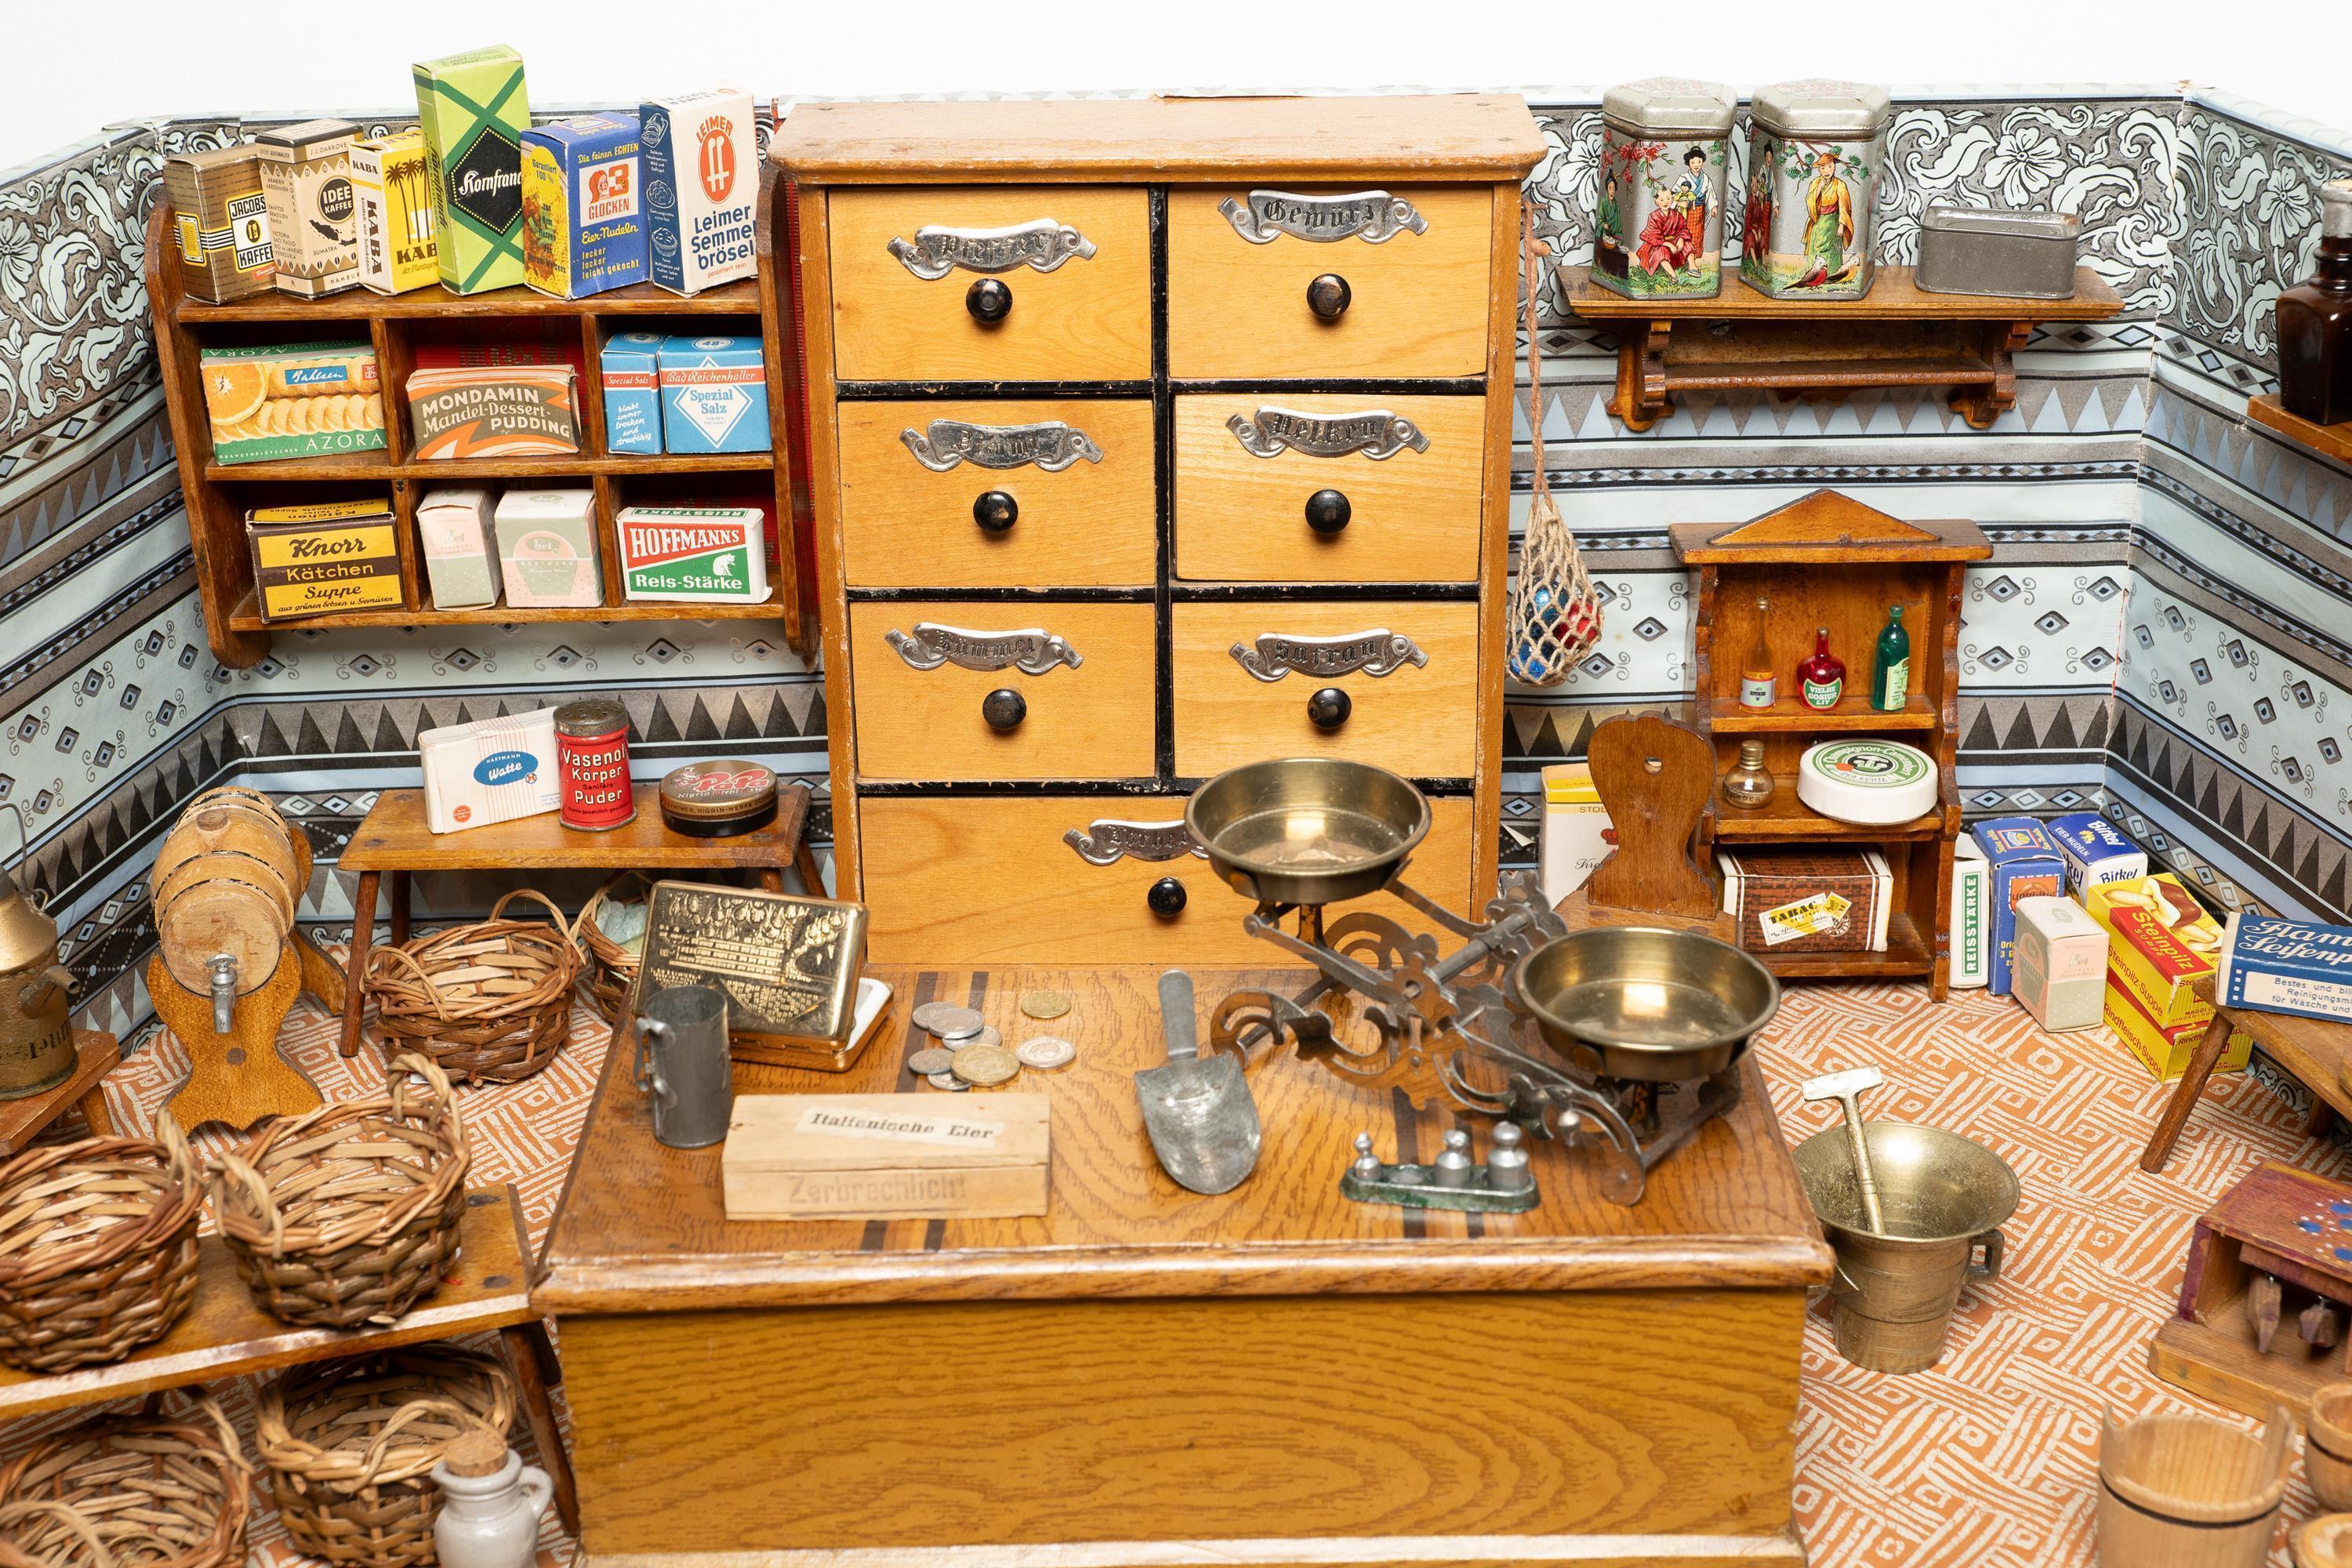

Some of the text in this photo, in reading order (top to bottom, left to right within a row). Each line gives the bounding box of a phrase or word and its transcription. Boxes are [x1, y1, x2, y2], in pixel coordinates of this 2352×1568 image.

[696, 115, 734, 143] LEIMER
[320, 142, 347, 153] DARBOVE
[578, 143, 639, 163] Die feinen ECHTEN
[353, 161, 379, 175] KABA
[532, 159, 557, 175] Garantiert
[535, 170, 546, 181] 100
[459, 169, 521, 197] Kornfranc
[609, 163, 629, 198] 3
[323, 186, 351, 205] IDEE
[231, 195, 266, 218] JACOBS
[325, 200, 353, 214] KAFFEE
[589, 198, 630, 220] GLOCKEN
[1263, 198, 1374, 229] Gewürz
[695, 205, 751, 234] Leimer
[367, 199, 383, 274] KABA
[582, 222, 639, 245] Eier-Nudeln
[691, 220, 757, 254] Semmel
[314, 245, 338, 256] SUMATRA
[396, 242, 437, 265] KAB
[583, 247, 606, 260] lecker
[698, 240, 754, 270] brösel
[941, 232, 1047, 264] Pfeffer
[402, 265, 411, 274] der
[583, 257, 606, 270] locker
[583, 267, 604, 280] leicht
[607, 259, 640, 276] gekocht
[707, 265, 734, 278] garantiert
[330, 273, 360, 284] HAMBUR
[209, 348, 288, 357] AZORA
[292, 368, 344, 383] Bahlsen
[608, 376, 649, 385] Spezial-Salz
[666, 369, 756, 383] Bad Reichenhaller
[422, 387, 540, 419] MONDAMIN
[690, 389, 734, 404] Spezial
[616, 410, 642, 420] immer
[618, 401, 640, 413] bleibt
[701, 403, 728, 415] Salz
[490, 416, 570, 439] PUDDING
[615, 417, 645, 430] trocken
[622, 426, 639, 437] und
[1272, 412, 1377, 445] Nelken
[306, 433, 383, 452] AZORA
[615, 432, 652, 447] streufähig
[289, 537, 367, 558] Knorr
[629, 528, 740, 558] HOFFMANNS
[286, 564, 374, 582] Kätchen
[636, 574, 742, 590] Reis-Stärke
[304, 586, 361, 599] Suppe
[295, 602, 321, 612] grünen
[323, 599, 347, 608] Erbsen
[358, 596, 394, 605] Gemüsen
[935, 630, 1036, 658] Kümmel
[1274, 639, 1377, 670] Safran
[486, 753, 521, 764] HARTMANN
[488, 762, 523, 781] Watte
[572, 766, 624, 784] Körper-
[575, 789, 622, 804] Puder
[677, 790, 710, 799] Nigrin
[2055, 827, 2091, 857] EIER NUDELN
[2086, 820, 2126, 846] Birkel
[2100, 869, 2138, 884] Birkel
[1769, 901, 1818, 924] TABAC
[1965, 877, 1977, 971] REISSTÄRKE
[2242, 920, 2352, 947] Flam
[2132, 912, 2194, 970] Steinpilz
[2134, 928, 2165, 957] SUPPE
[2238, 935, 2352, 966] Seifenp
[2107, 945, 2165, 1017] Steinpilz-Suppe
[2274, 978, 2307, 989] Bestes
[2314, 984, 2332, 993] und
[2286, 989, 2352, 1004] Reinigungsmi
[2290, 996, 2328, 1010] Wäsche
[2185, 1007, 2207, 1016] MAGGI
[2103, 1004, 2162, 1076] Rindfleisch-Suppe
[809, 1112, 994, 1140] Italienische Eier
[788, 1174, 968, 1205] Zerbrechlich!
